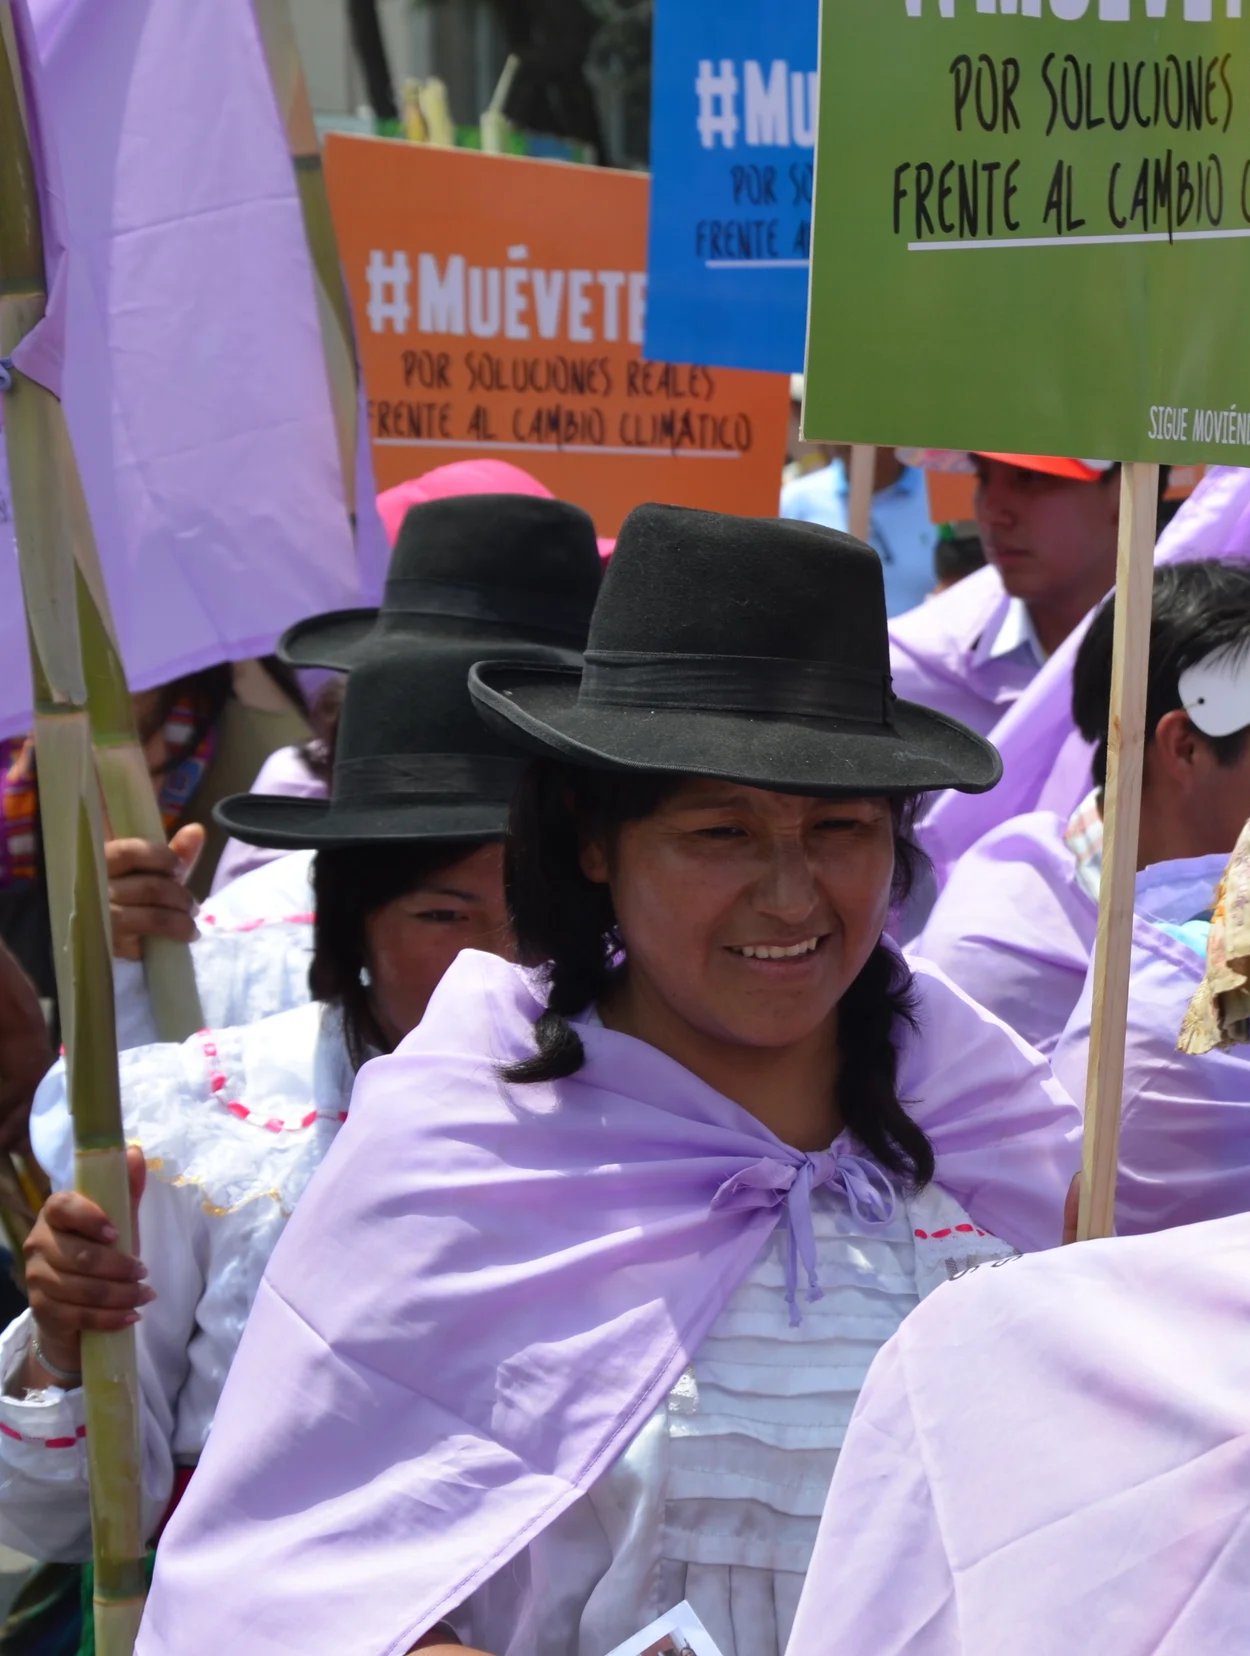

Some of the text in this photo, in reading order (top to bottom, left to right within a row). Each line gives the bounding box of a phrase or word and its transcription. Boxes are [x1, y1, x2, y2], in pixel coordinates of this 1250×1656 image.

[949, 54, 1021, 134] POR
[1041, 52, 1233, 136] SOLUCIONES
[730, 163, 778, 207] POR
[893, 157, 1021, 239] FRENTE
[1043, 159, 1086, 234] AL
[1108, 148, 1224, 245] CAMBIO
[695, 217, 779, 259] FRENTE
[365, 244, 647, 344] #MUÉVETE
[401, 350, 716, 403] POR SOLUCIONES REALES
[467, 403, 497, 442] AL
[511, 401, 606, 453] CAMBIO
[1148, 405, 1189, 441] SIGUE
